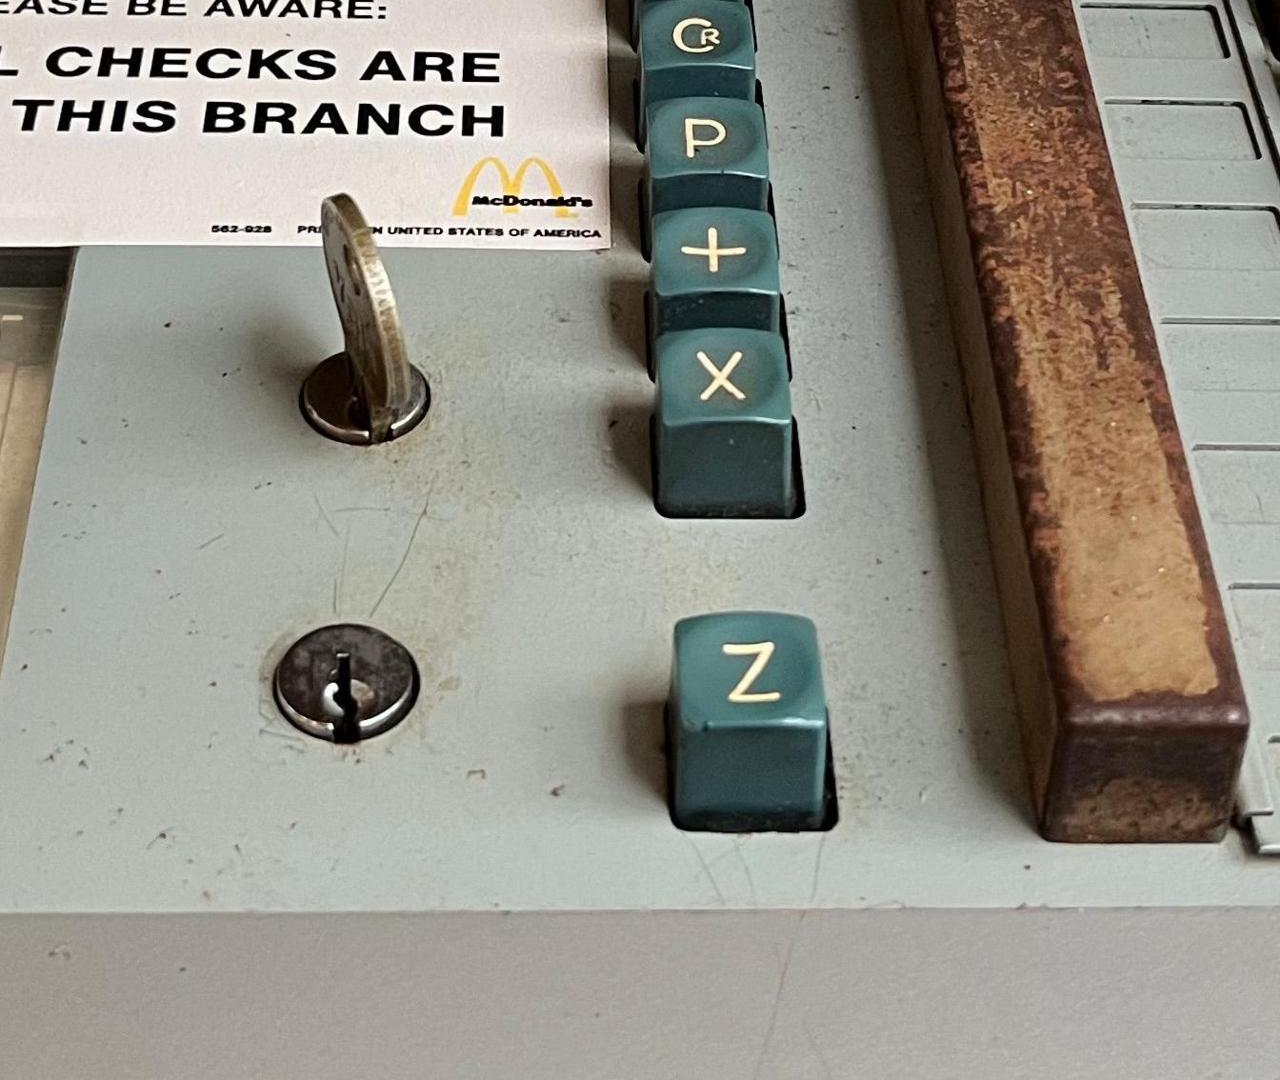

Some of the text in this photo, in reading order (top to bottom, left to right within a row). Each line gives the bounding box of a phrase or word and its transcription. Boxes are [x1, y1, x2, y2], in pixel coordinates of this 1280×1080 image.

[45, 46, 337, 81] CHECKS
[359, 50, 501, 83] ARE
[11, 99, 177, 134] THIS
[202, 101, 504, 138] BRANCH
[684, 118, 726, 158] P
[471, 194, 594, 208] McDonald's
[387, 226, 444, 236] UNITED
[447, 227, 504, 237] STATES
[508, 228, 530, 237] OF
[533, 228, 602, 239] AMERICA
[722, 641, 781, 702] Z
